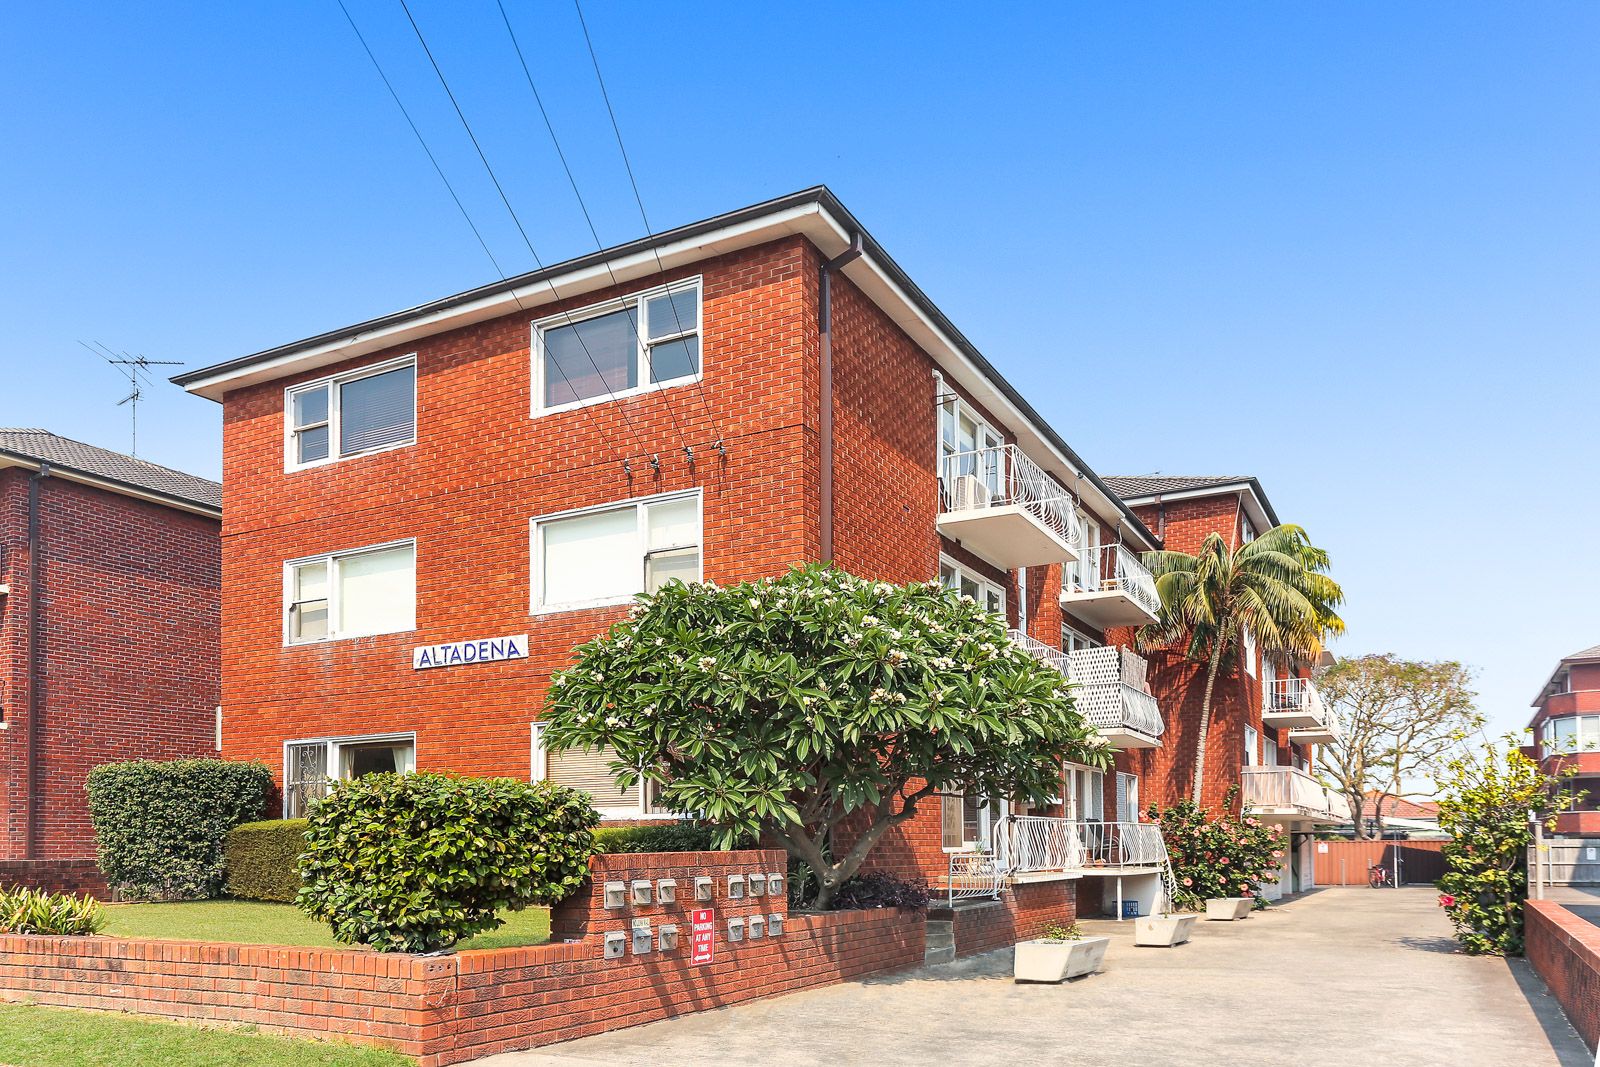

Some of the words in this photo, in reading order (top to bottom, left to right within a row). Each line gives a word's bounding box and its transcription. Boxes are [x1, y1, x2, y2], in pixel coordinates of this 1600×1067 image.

[419, 639, 521, 667] ALTADENA
[694, 922, 713, 931] PARKING
[696, 934, 701, 942] AT
[702, 933, 711, 942] ANY
[698, 944, 708, 952] TIME
